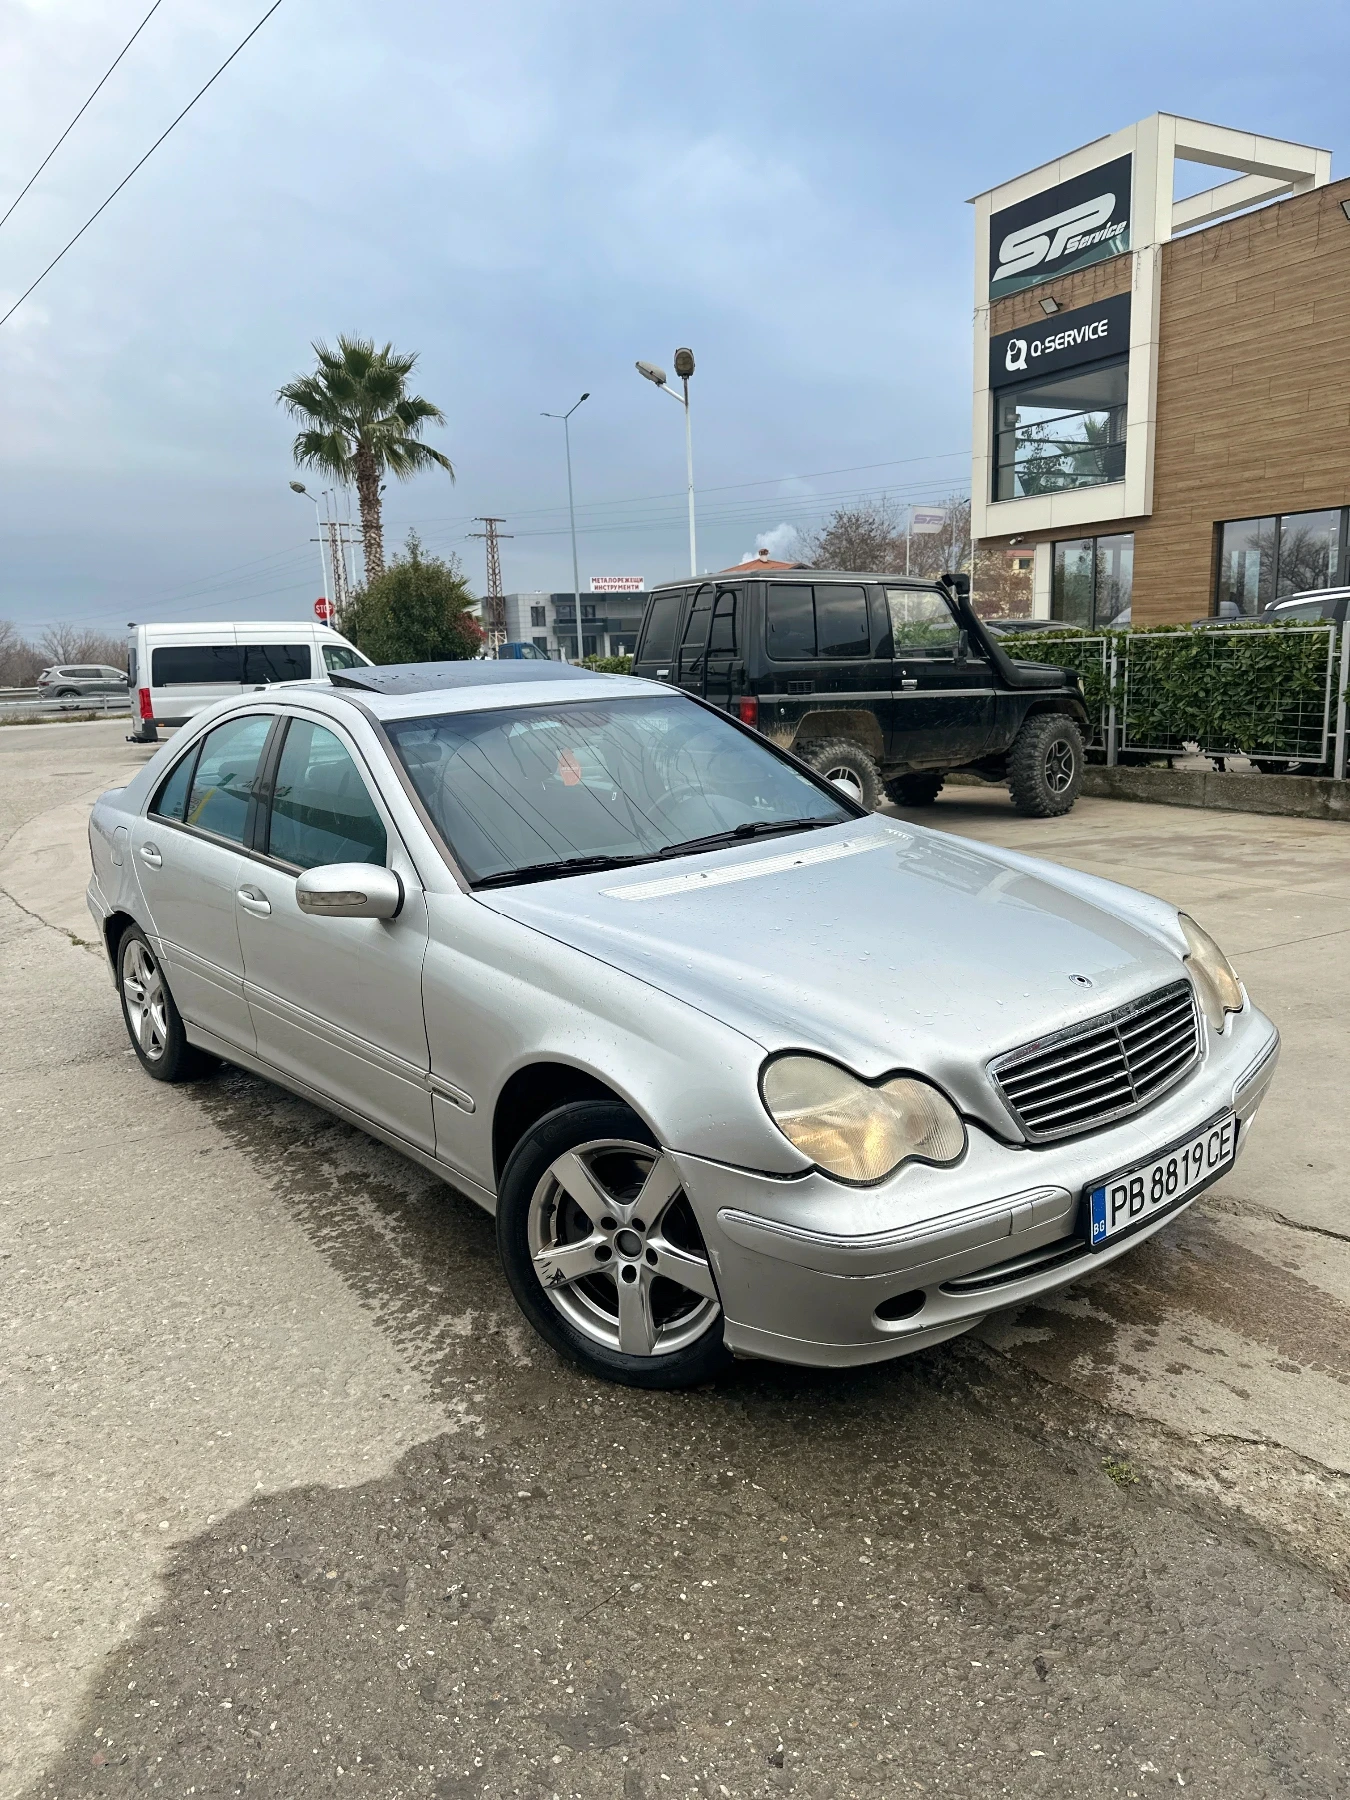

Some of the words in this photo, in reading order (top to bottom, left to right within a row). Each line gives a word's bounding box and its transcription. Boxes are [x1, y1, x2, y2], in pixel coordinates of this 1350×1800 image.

[992, 192, 1116, 282] SP
[1064, 220, 1127, 254] Service
[1111, 1176, 1145, 1228] PB
[1150, 1141, 1204, 1204] 8819
[1207, 1121, 1232, 1168] CE
[1093, 1220, 1105, 1235] BG
